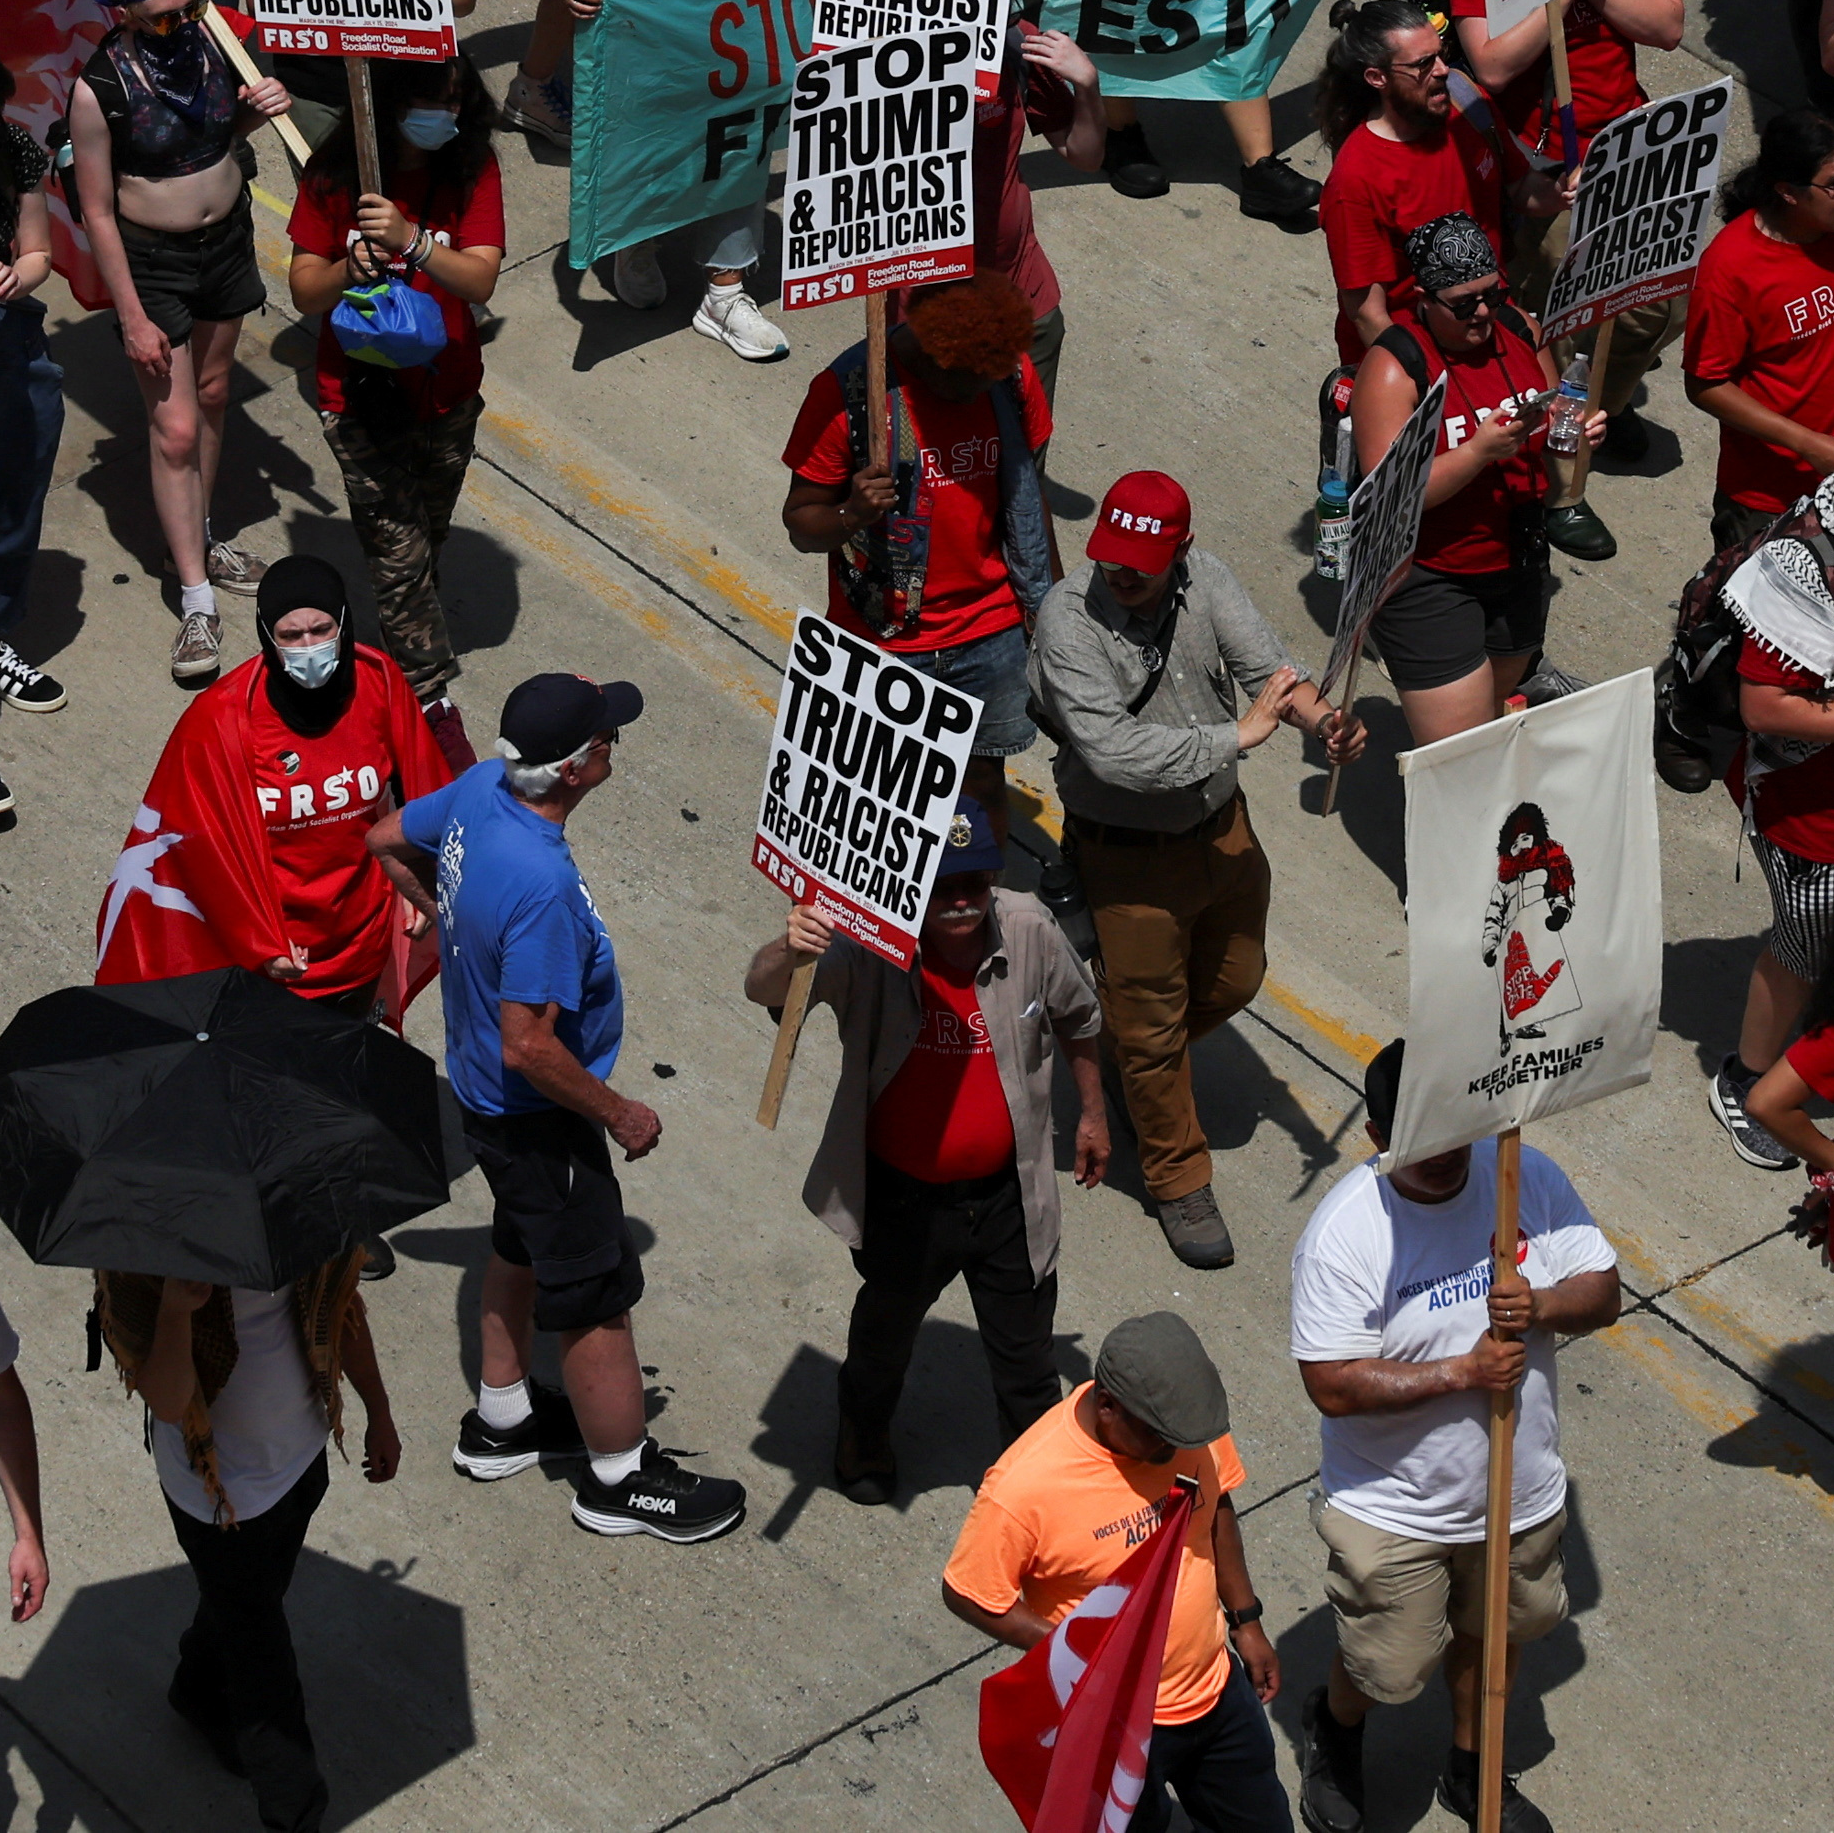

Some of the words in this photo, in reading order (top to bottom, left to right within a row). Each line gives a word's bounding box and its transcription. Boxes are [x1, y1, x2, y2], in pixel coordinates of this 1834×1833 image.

[1468, 1064, 1508, 1095] KEEP
[1512, 1036, 1604, 1071] FAMILIES
[1486, 1057, 1583, 1101] TOGETHER
